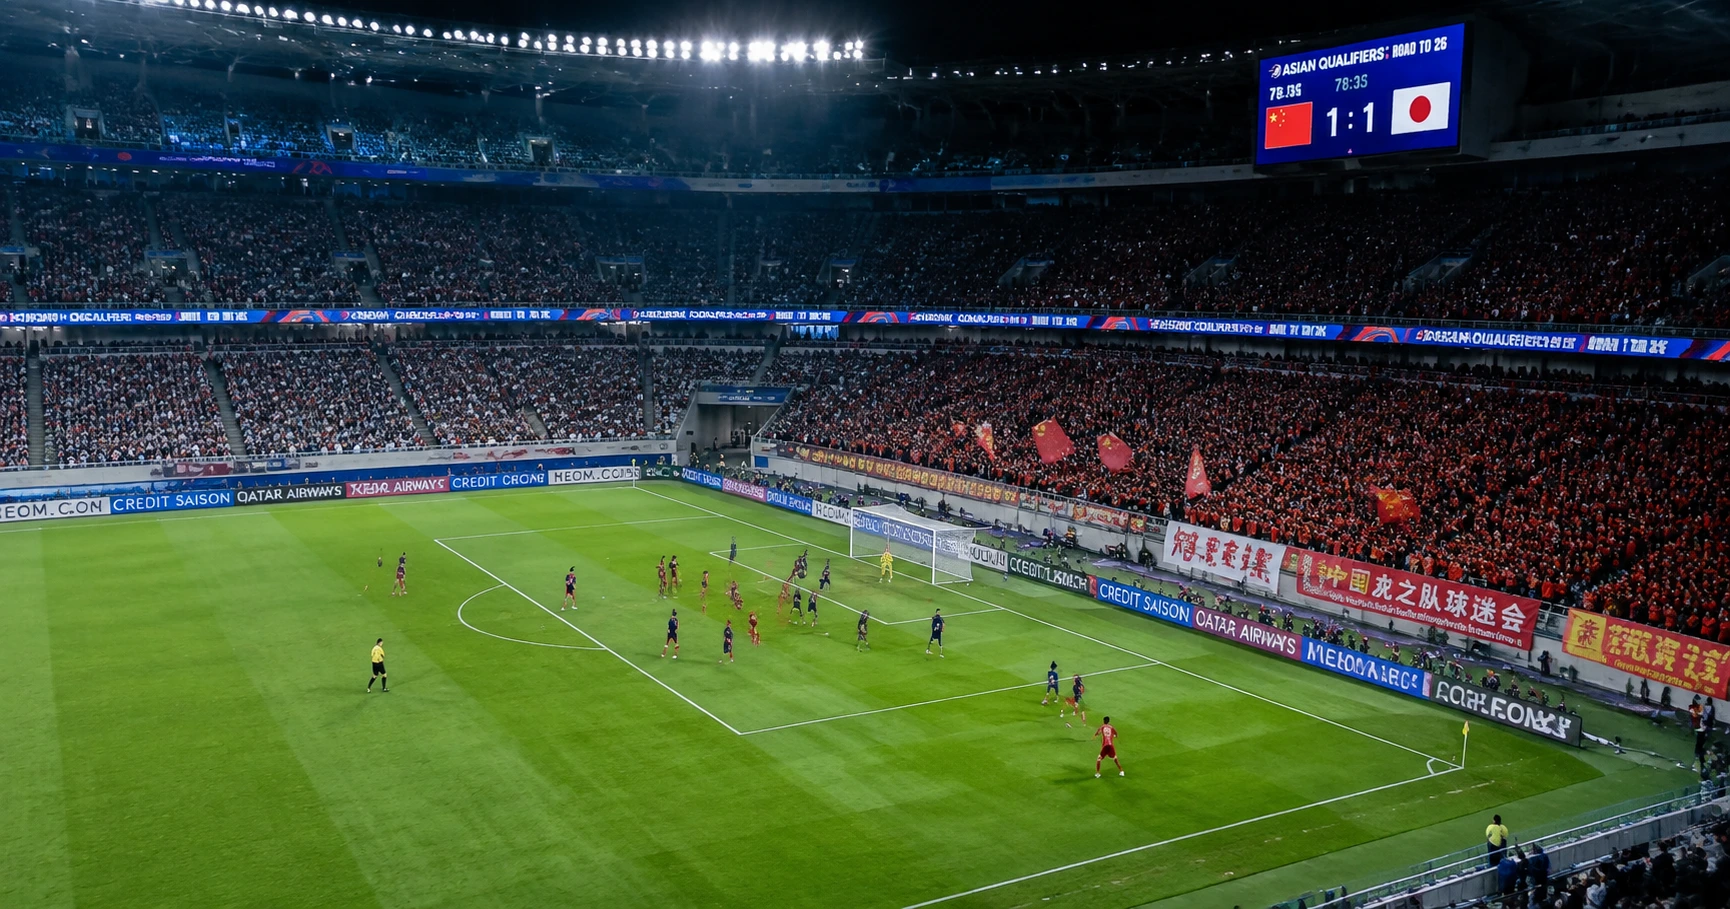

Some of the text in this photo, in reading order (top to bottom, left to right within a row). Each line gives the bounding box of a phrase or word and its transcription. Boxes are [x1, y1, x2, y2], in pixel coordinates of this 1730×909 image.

[1282, 58, 1316, 76] ASIAN
[1392, 42, 1416, 58] ROAD
[1418, 40, 1431, 53] TO
[1433, 36, 1448, 51] 26
[236, 489, 283, 504] QATAR
[452, 476, 498, 489] CREDIT
[113, 492, 231, 511] CREDIT SAISON
[1099, 583, 1191, 623] CREDIT SAISON
[1195, 609, 1297, 655] QATAR AIRWAYS
